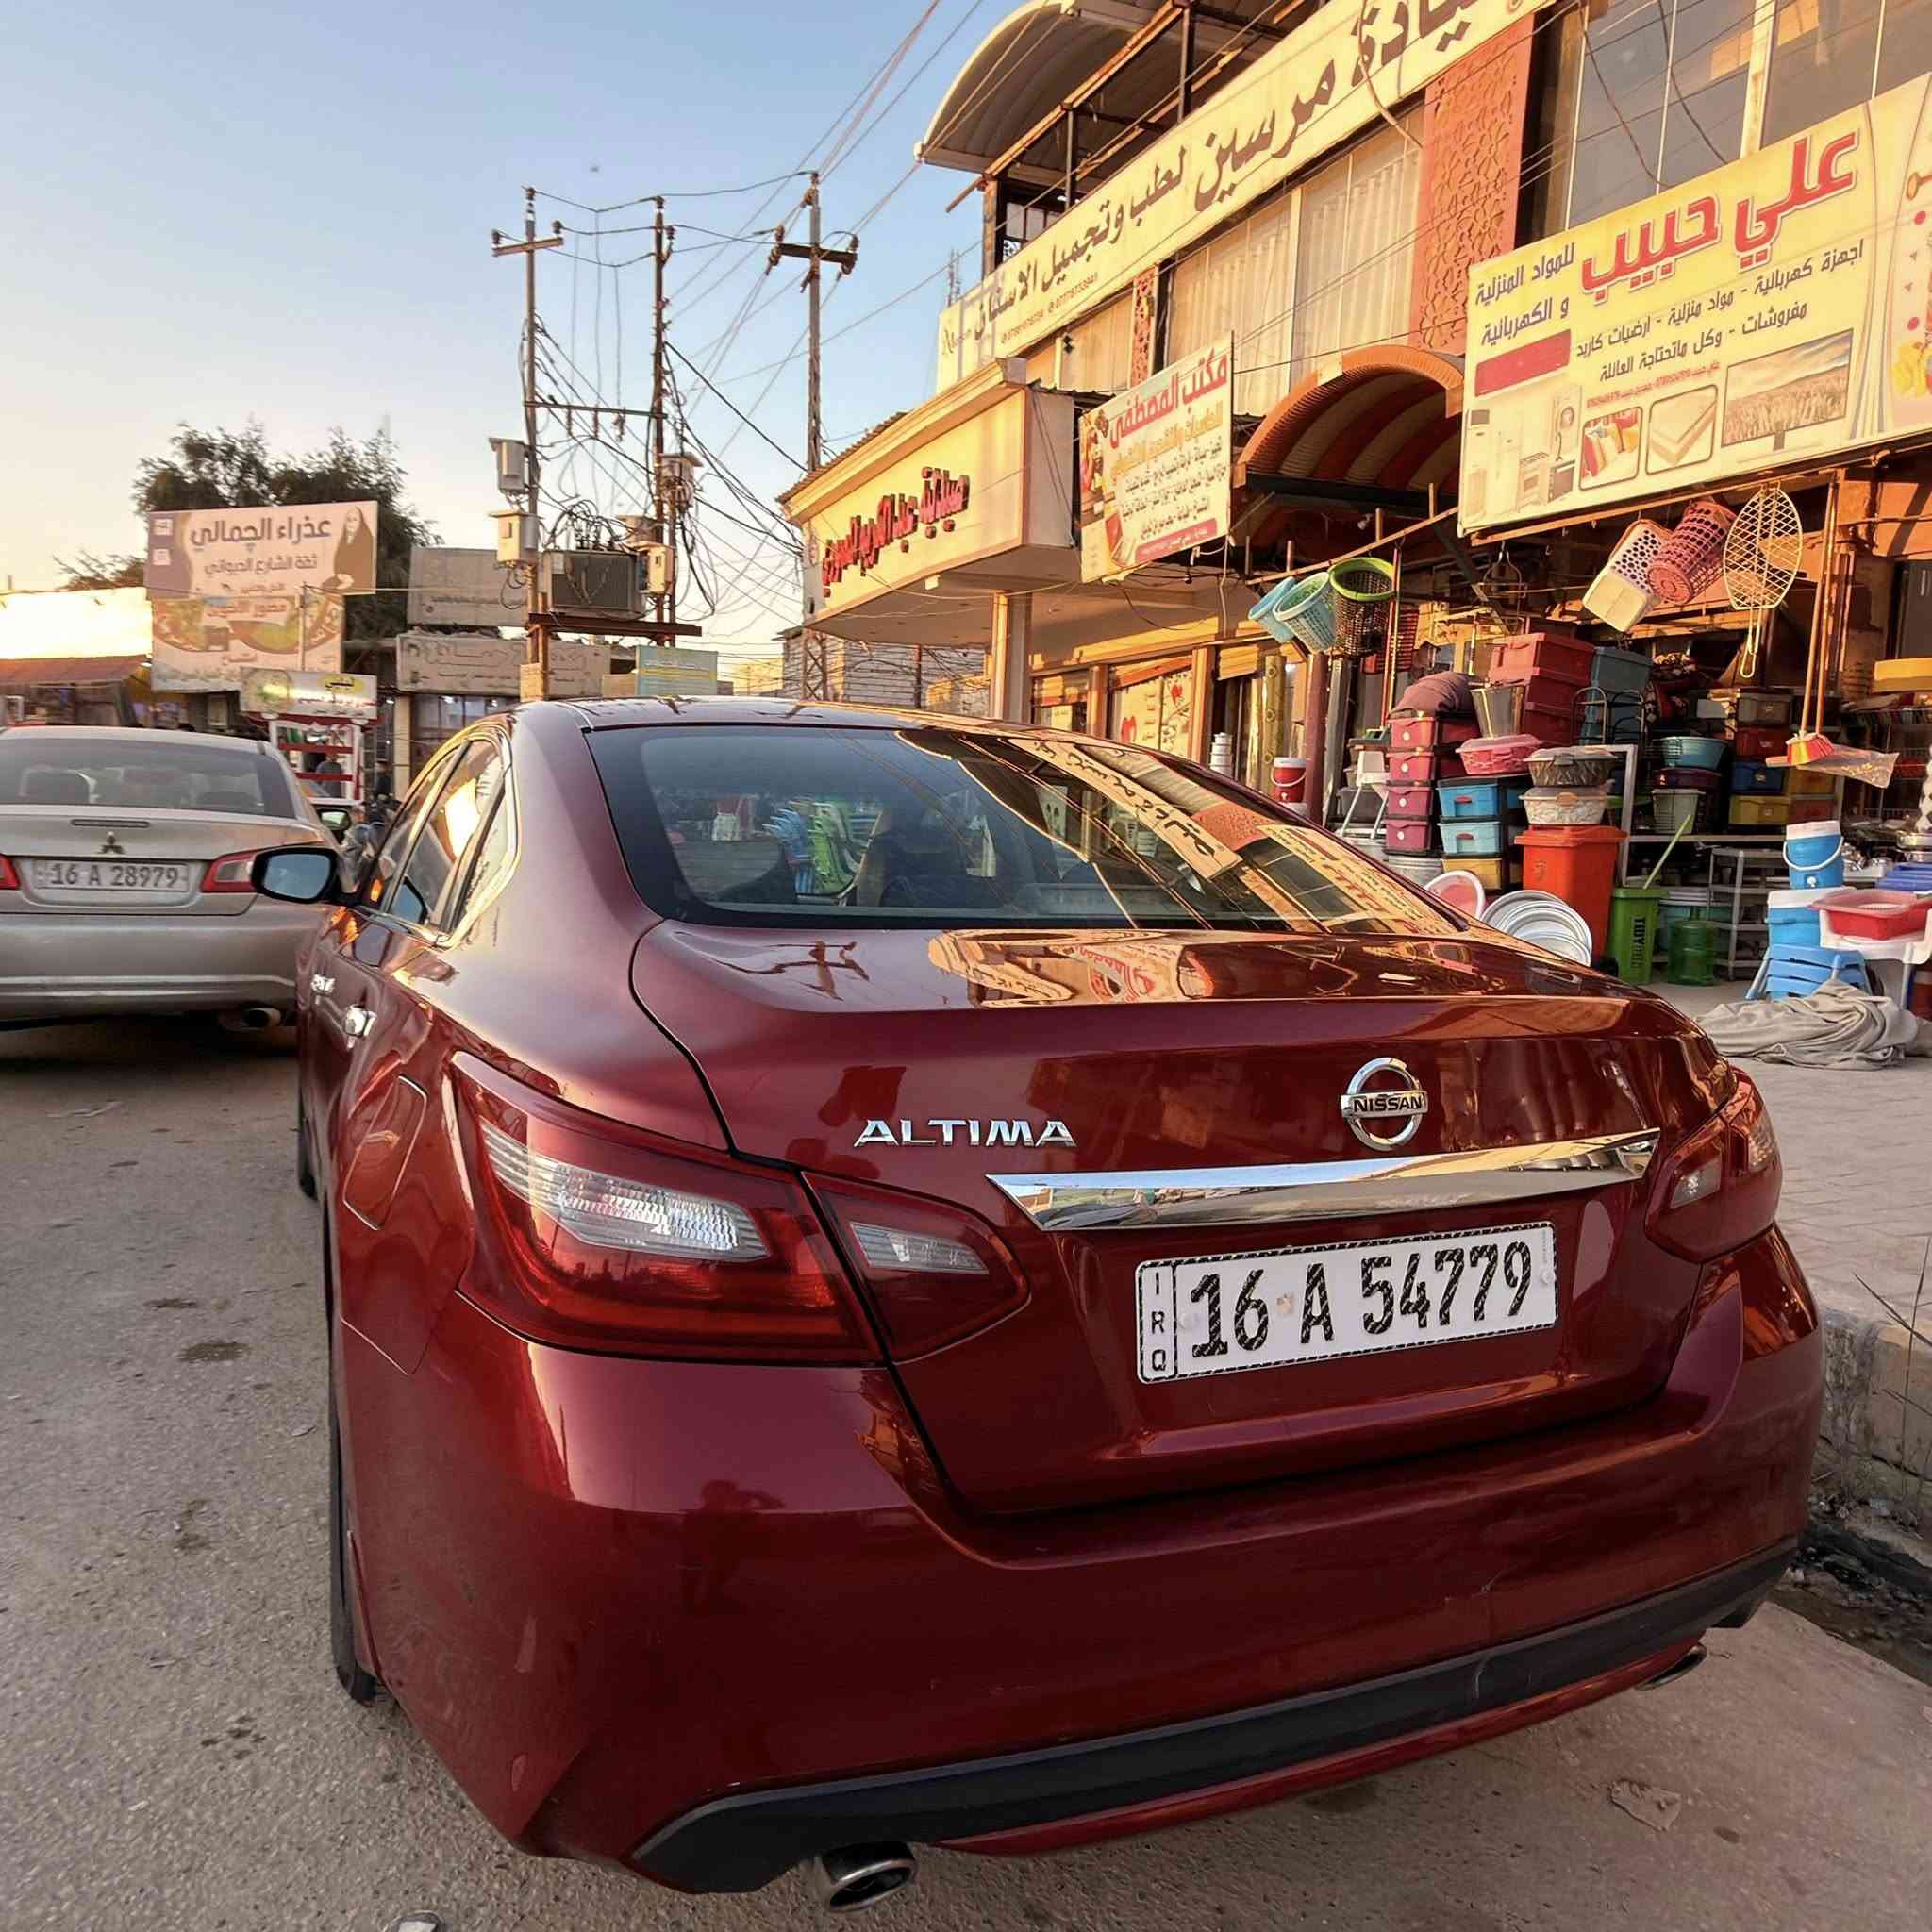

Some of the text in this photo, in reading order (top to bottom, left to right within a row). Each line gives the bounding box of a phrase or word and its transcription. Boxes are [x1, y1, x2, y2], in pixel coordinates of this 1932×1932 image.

[1194, 60, 1336, 212] مرسين
[1130, 144, 1186, 226] لطب
[1580, 131, 1858, 301] علي حبيب
[1042, 200, 1124, 292] وتجميل
[1821, 239, 1864, 272] اجهزة
[1475, 242, 1575, 305] للمواد المنزلية
[1668, 302, 1702, 325] منزلية
[1707, 291, 1734, 313] مواد
[1741, 302, 1807, 335] مفروشات
[1481, 297, 1570, 346] و الكهربائية
[1607, 316, 1650, 345] ارضيات
[1693, 329, 1722, 355] وكل
[1182, 347, 1229, 414] مكتب
[1600, 356, 1634, 382] العائلة
[1109, 372, 1180, 450] المصطفى
[276, 515, 332, 545] عذراء
[51, 863, 77, 884] 16
[89, 865, 101, 885] A
[110, 866, 178, 887] 28979
[1352, 1096, 1424, 1113] NISSAN
[854, 1118, 1077, 1147] ALTIMA
[1191, 1241, 1532, 1358] 16 A 54779
[1152, 1272, 1167, 1372] IRQ
